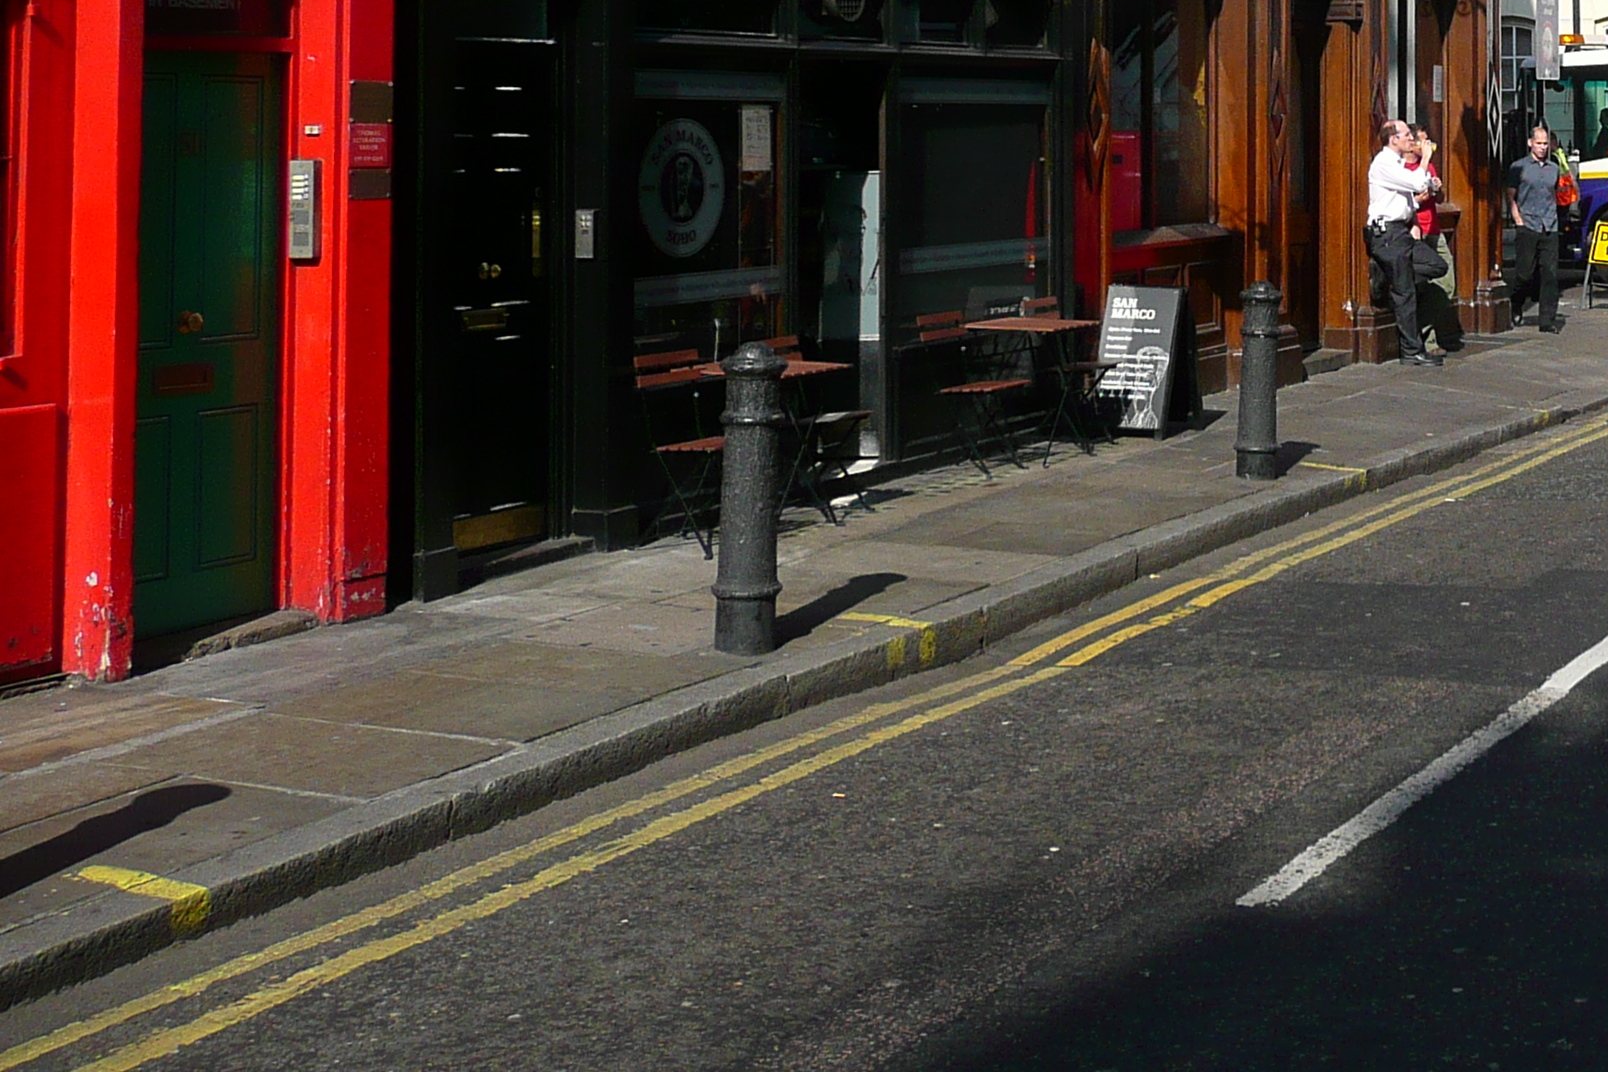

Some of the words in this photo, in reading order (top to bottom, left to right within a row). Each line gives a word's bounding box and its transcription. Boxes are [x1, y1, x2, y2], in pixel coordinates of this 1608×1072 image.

[651, 133, 673, 164] SAN
[676, 129, 714, 166] MARCO
[666, 229, 697, 246] SOHO
[1112, 297, 1139, 308] SAN
[1111, 308, 1156, 320] MARCO
